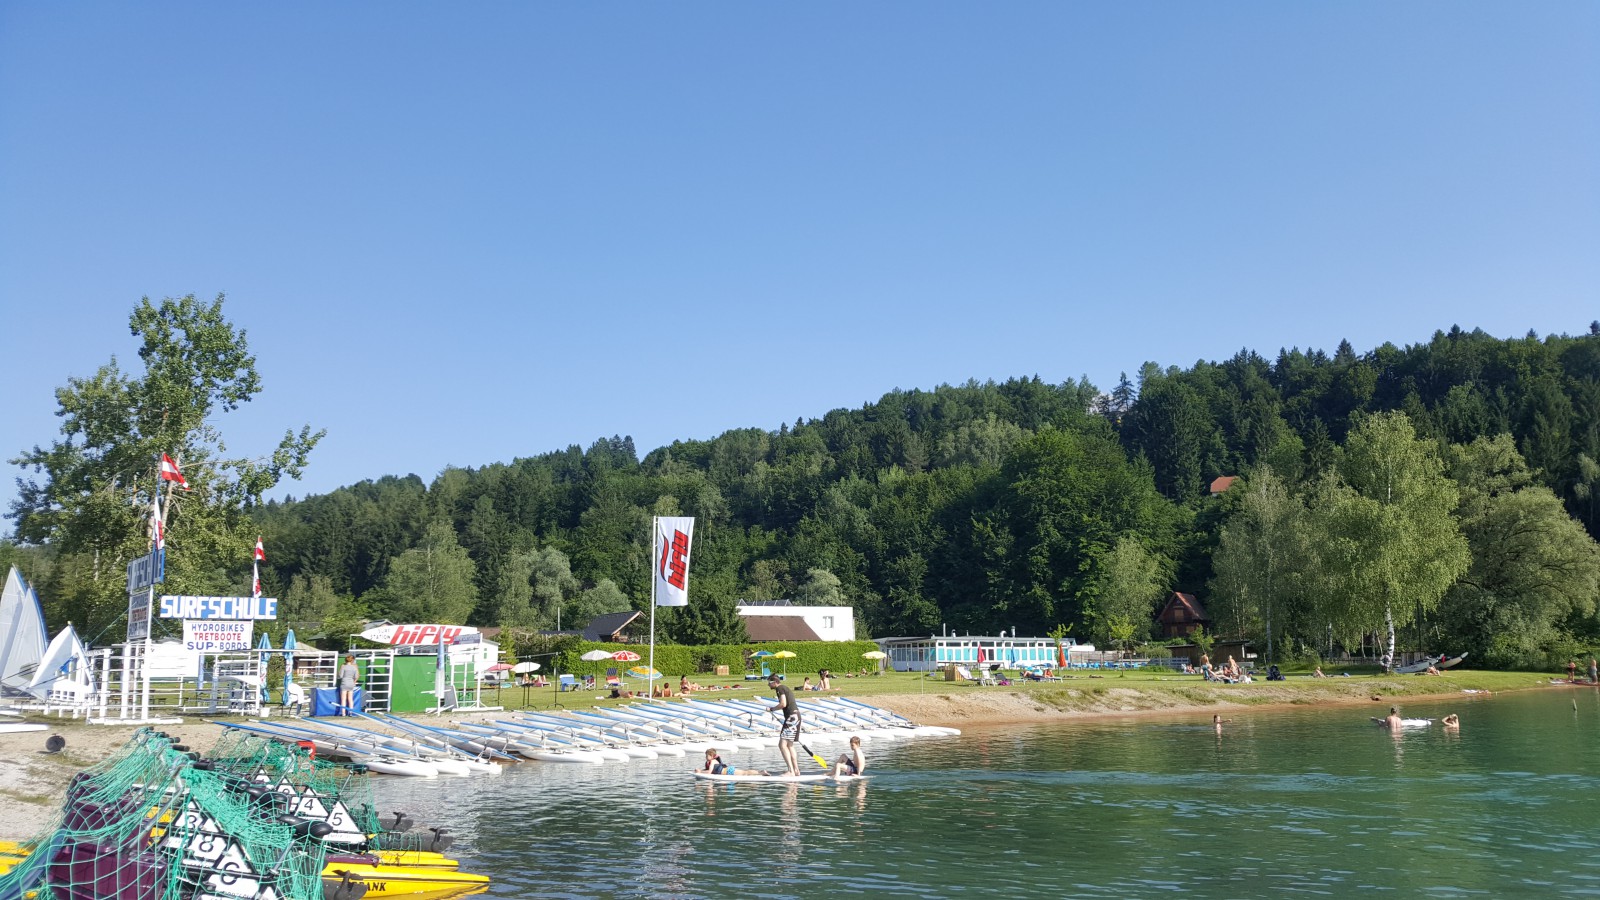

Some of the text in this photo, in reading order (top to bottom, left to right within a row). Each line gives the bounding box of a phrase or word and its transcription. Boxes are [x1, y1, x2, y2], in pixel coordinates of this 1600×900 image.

[160, 596, 277, 619] SURFSCHULE
[191, 623, 245, 632] HYDROBIKES
[194, 633, 242, 641] TRETBOOTE
[304, 798, 314, 811] 4
[331, 812, 343, 827] 5
